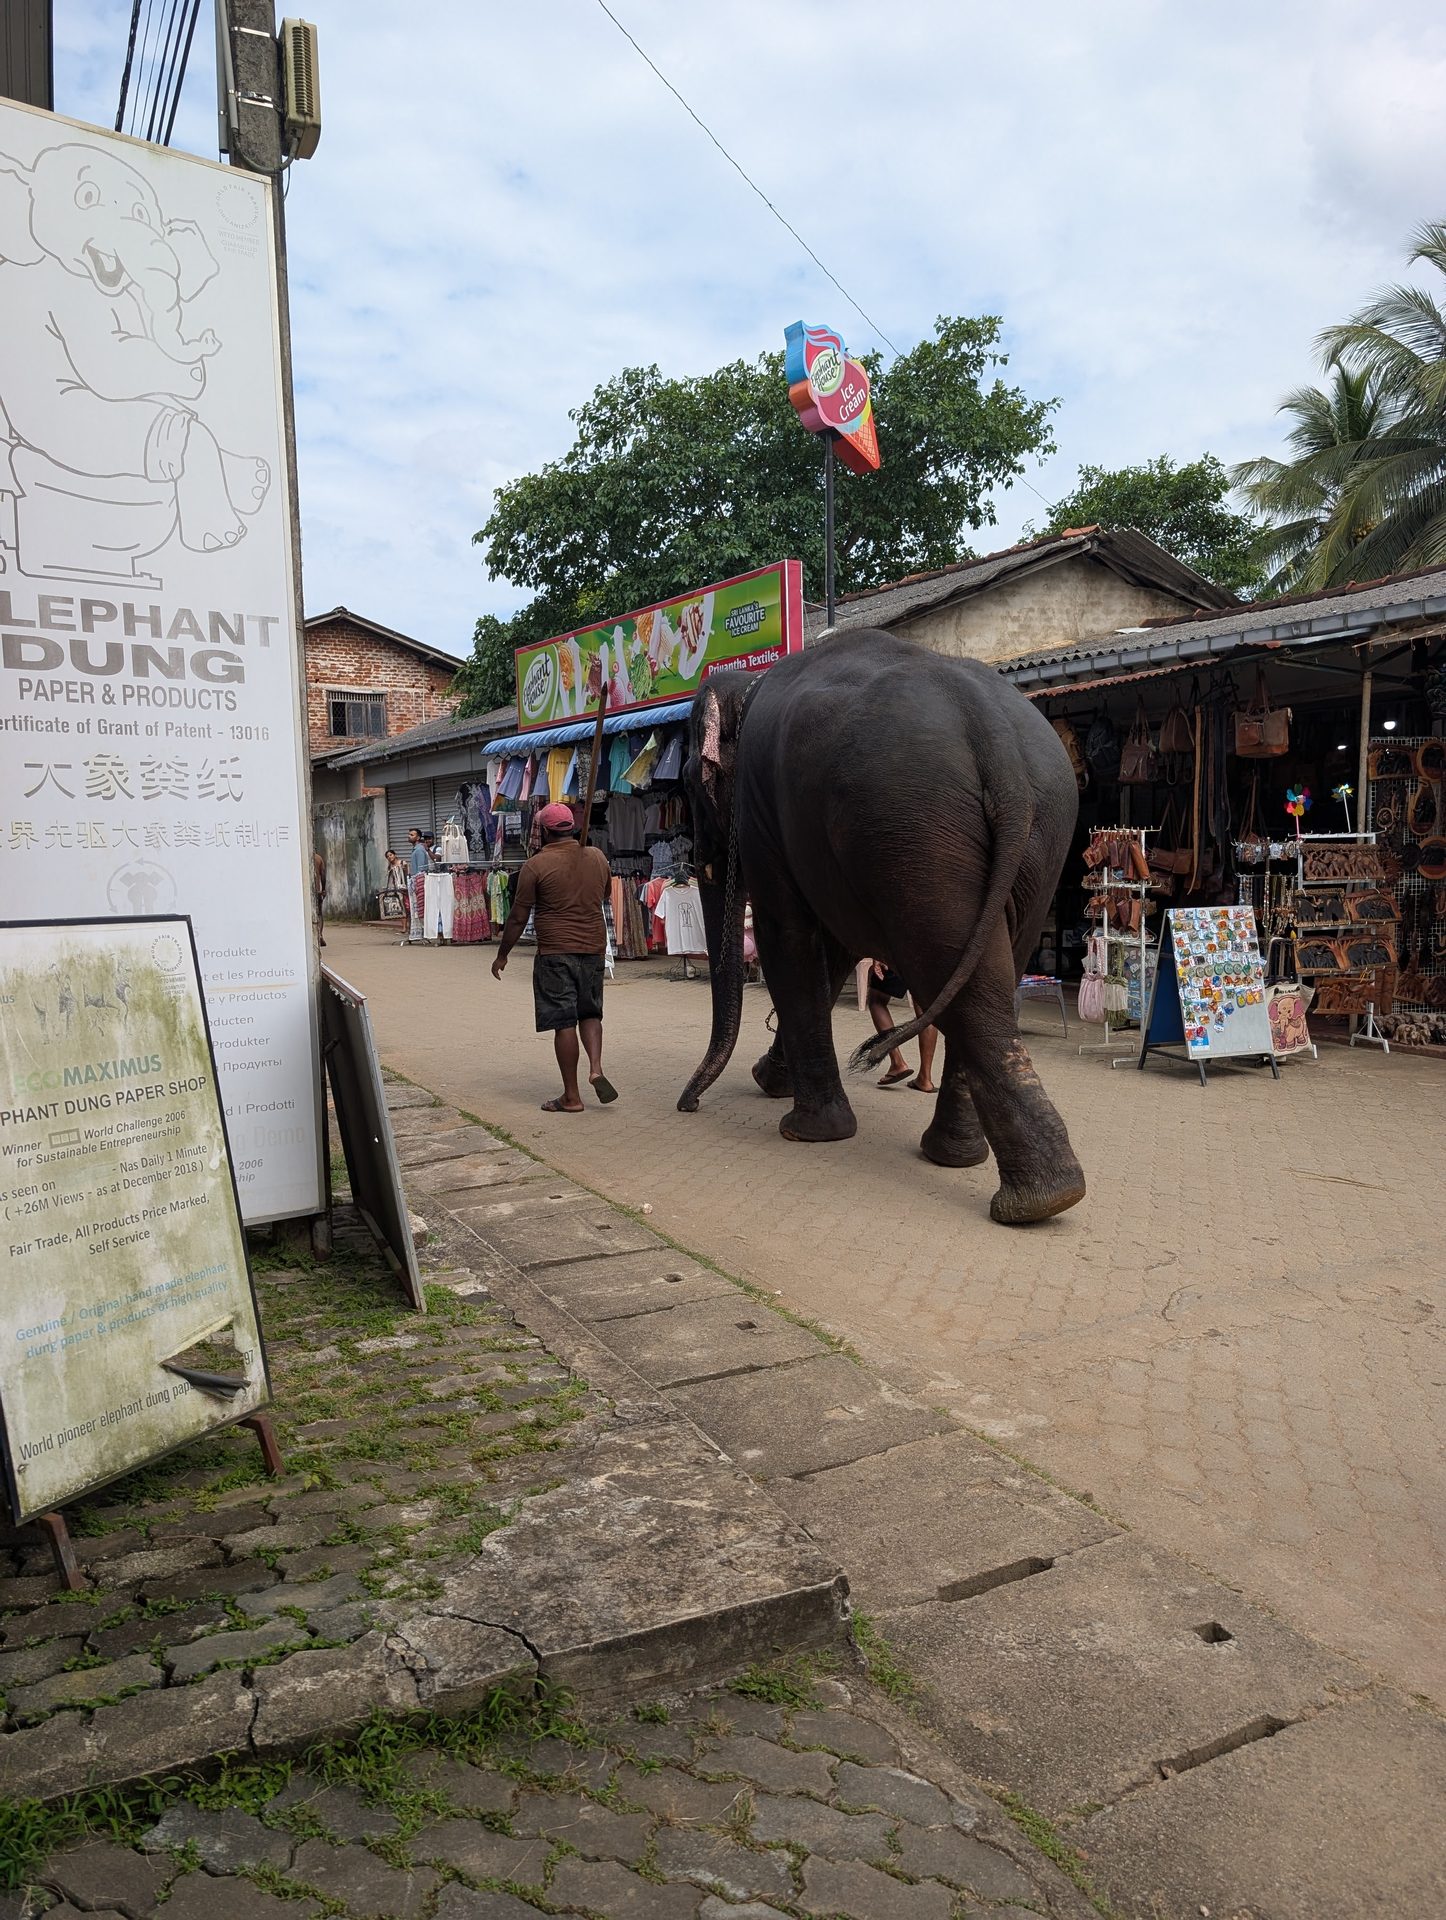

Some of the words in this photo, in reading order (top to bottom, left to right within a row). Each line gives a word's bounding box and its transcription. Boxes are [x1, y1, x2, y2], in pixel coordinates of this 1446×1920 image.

[839, 388, 866, 421] Cream
[841, 383, 855, 402] Ice
[0, 590, 280, 648] LEPHANT
[725, 608, 765, 629] FAVOURITE
[732, 628, 740, 636] ICE
[740, 622, 759, 634] CREAM
[1, 633, 246, 684] DUNG
[748, 650, 779, 667] Textiles
[18, 678, 95, 704] PAPER
[101, 684, 117, 705] &
[122, 684, 237, 711] PRODUCTS
[0, 715, 70, 733] rtificate
[76, 718, 91, 734] of
[97, 719, 140, 736] Grant
[145, 721, 159, 737] of
[165, 722, 212, 739] Patent
[229, 725, 270, 741] 13016
[24, 753, 243, 802] 大象粪纸
[203, 947, 257, 959] Produkte
[211, 972, 225, 981] et
[228, 970, 244, 980] les
[247, 968, 295, 979] Produits
[229, 991, 287, 1003] Productos
[208, 1016, 254, 1027] oducten
[212, 1037, 270, 1049] Produkter
[223, 1059, 282, 1072] Продукты
[0, 1102, 60, 1126] PHANT
[65, 1094, 112, 1115] DUNG
[116, 1085, 166, 1106] PAPER
[169, 1076, 207, 1095] SHOP
[246, 1099, 295, 1114] Prodotti
[2, 1141, 42, 1157] Winner
[84, 1127, 114, 1140] World
[117, 1115, 163, 1133] Challenge
[165, 1110, 186, 1123] 2006
[17, 1152, 33, 1168] for
[36, 1143, 98, 1164] Sustainable
[100, 1125, 181, 1151] Entrepreneurship
[11, 1184, 39, 1199] seen
[42, 1181, 56, 1192] on
[120, 1161, 139, 1174] Nas
[141, 1152, 165, 1169] Daily
[166, 1151, 173, 1162] 1
[175, 1145, 208, 1160] Minute
[239, 1158, 264, 1171] 2006
[14, 1198, 50, 1217] +26M
[52, 1191, 85, 1208] Views
[96, 1187, 109, 1197] as
[110, 1182, 121, 1193] at
[123, 1170, 172, 1191] December
[174, 1161, 198, 1177] 2018
[9, 1243, 32, 1257] Fair
[35, 1232, 72, 1250] Trade,
[75, 1225, 90, 1240] All
[92, 1214, 140, 1236] Products
[142, 1207, 168, 1221] Price
[169, 1192, 210, 1212] Marked,
[89, 1238, 110, 1255] Self
[112, 1229, 151, 1249] Service
[15, 1317, 67, 1342] Genuine
[79, 1296, 123, 1320] Original
[125, 1285, 152, 1305] hand
[154, 1276, 184, 1295] made
[25, 1340, 57, 1359] dung
[60, 1328, 95, 1350] paper
[97, 1321, 107, 1335] &
[109, 1305, 156, 1333] products
[158, 1298, 170, 1313] of
[170, 1291, 193, 1311] high
[194, 1280, 228, 1302] quality
[243, 1350, 255, 1366] 97
[19, 1433, 54, 1461] World
[57, 1418, 97, 1449] pioneer
[100, 1398, 144, 1427] elephant
[146, 1388, 171, 1408] dung
[172, 1381, 195, 1402] pap
